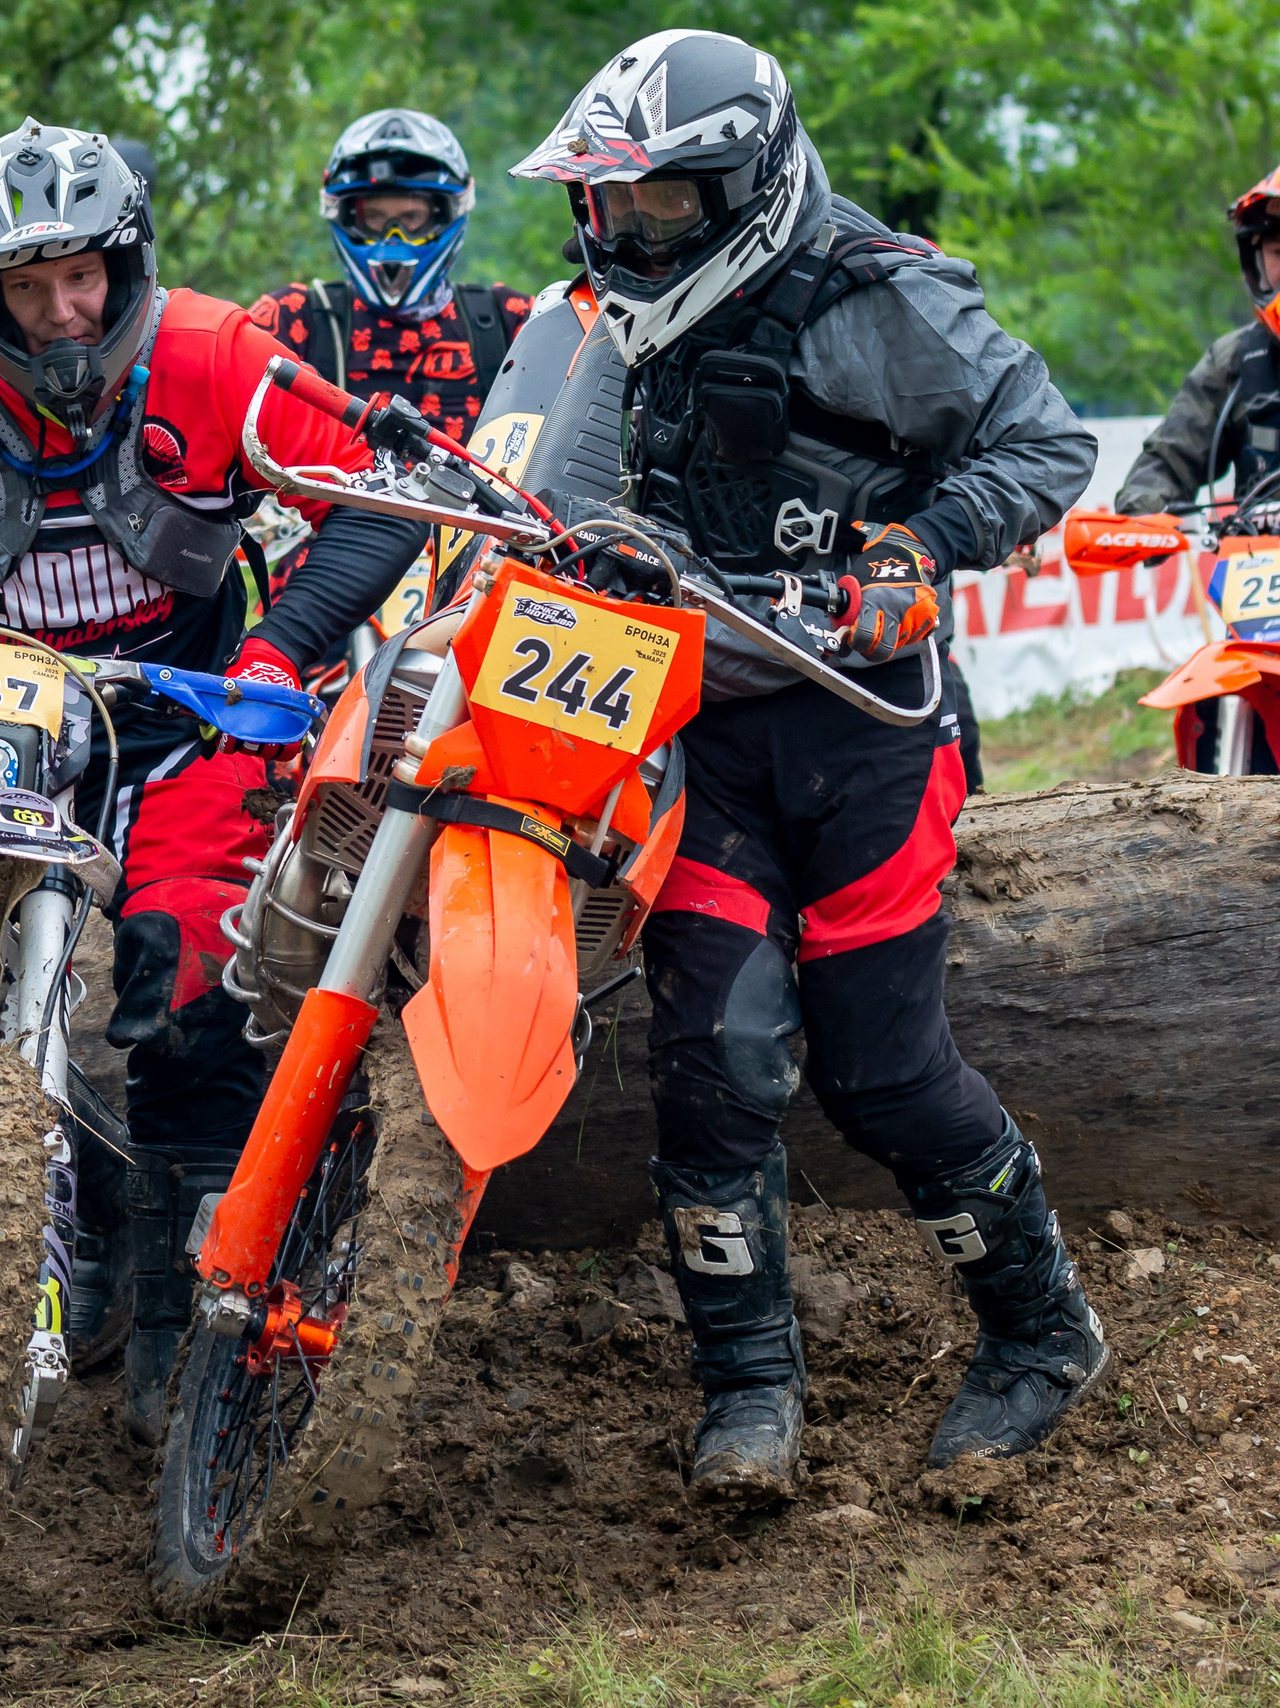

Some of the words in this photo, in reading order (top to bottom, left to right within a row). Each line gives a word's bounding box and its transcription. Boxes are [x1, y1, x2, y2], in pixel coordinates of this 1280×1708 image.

[7, 223, 63, 243] ATAKI
[635, 551, 660, 567] RACE
[624, 624, 670, 648] БРОНЗА
[14, 651, 59, 667] БРОНЗА
[637, 652, 664, 665] САМАРА
[32, 670, 59, 680] САМАРА
[500, 636, 637, 731] 244
